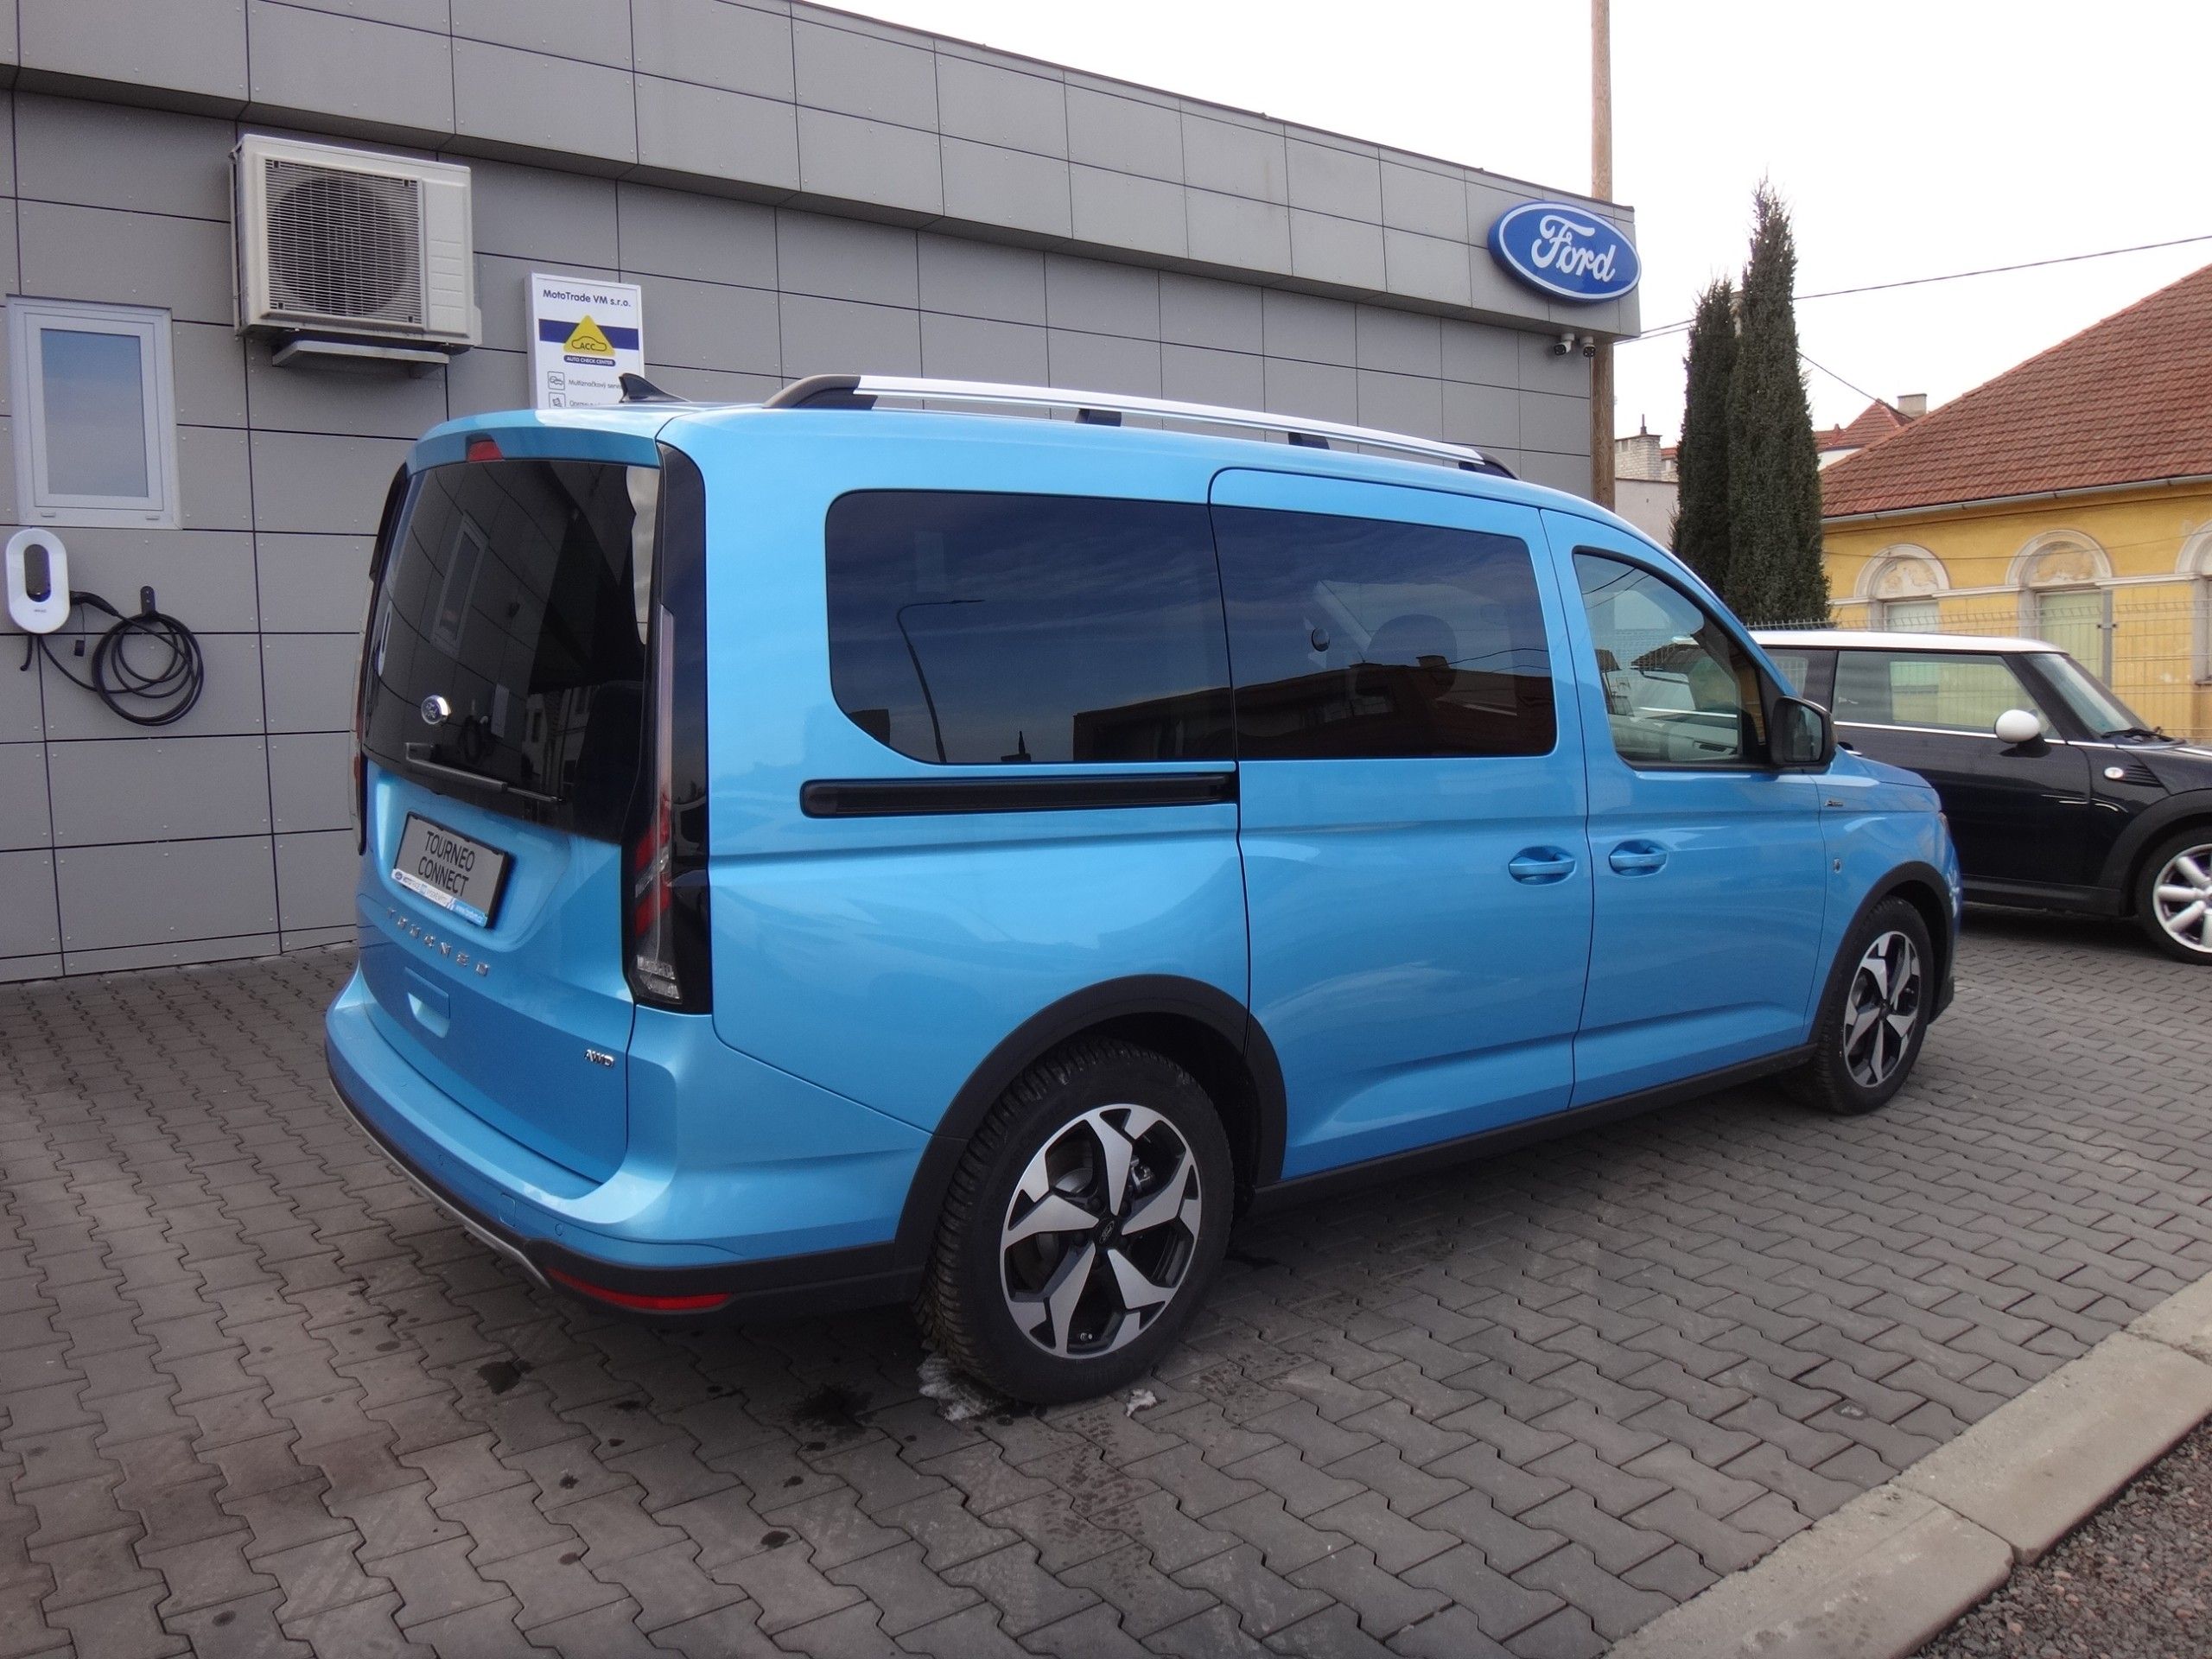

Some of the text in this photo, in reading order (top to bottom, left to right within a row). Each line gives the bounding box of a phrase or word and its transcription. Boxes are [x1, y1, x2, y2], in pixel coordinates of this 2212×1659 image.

[1530, 214, 1616, 283] Ford
[543, 289, 632, 308] MotoTrade VM s.r.o.
[580, 342, 596, 351] ACC
[424, 830, 475, 872] TOURNEO
[417, 855, 470, 897] CONNECT
[584, 1049, 615, 1068] AWD
